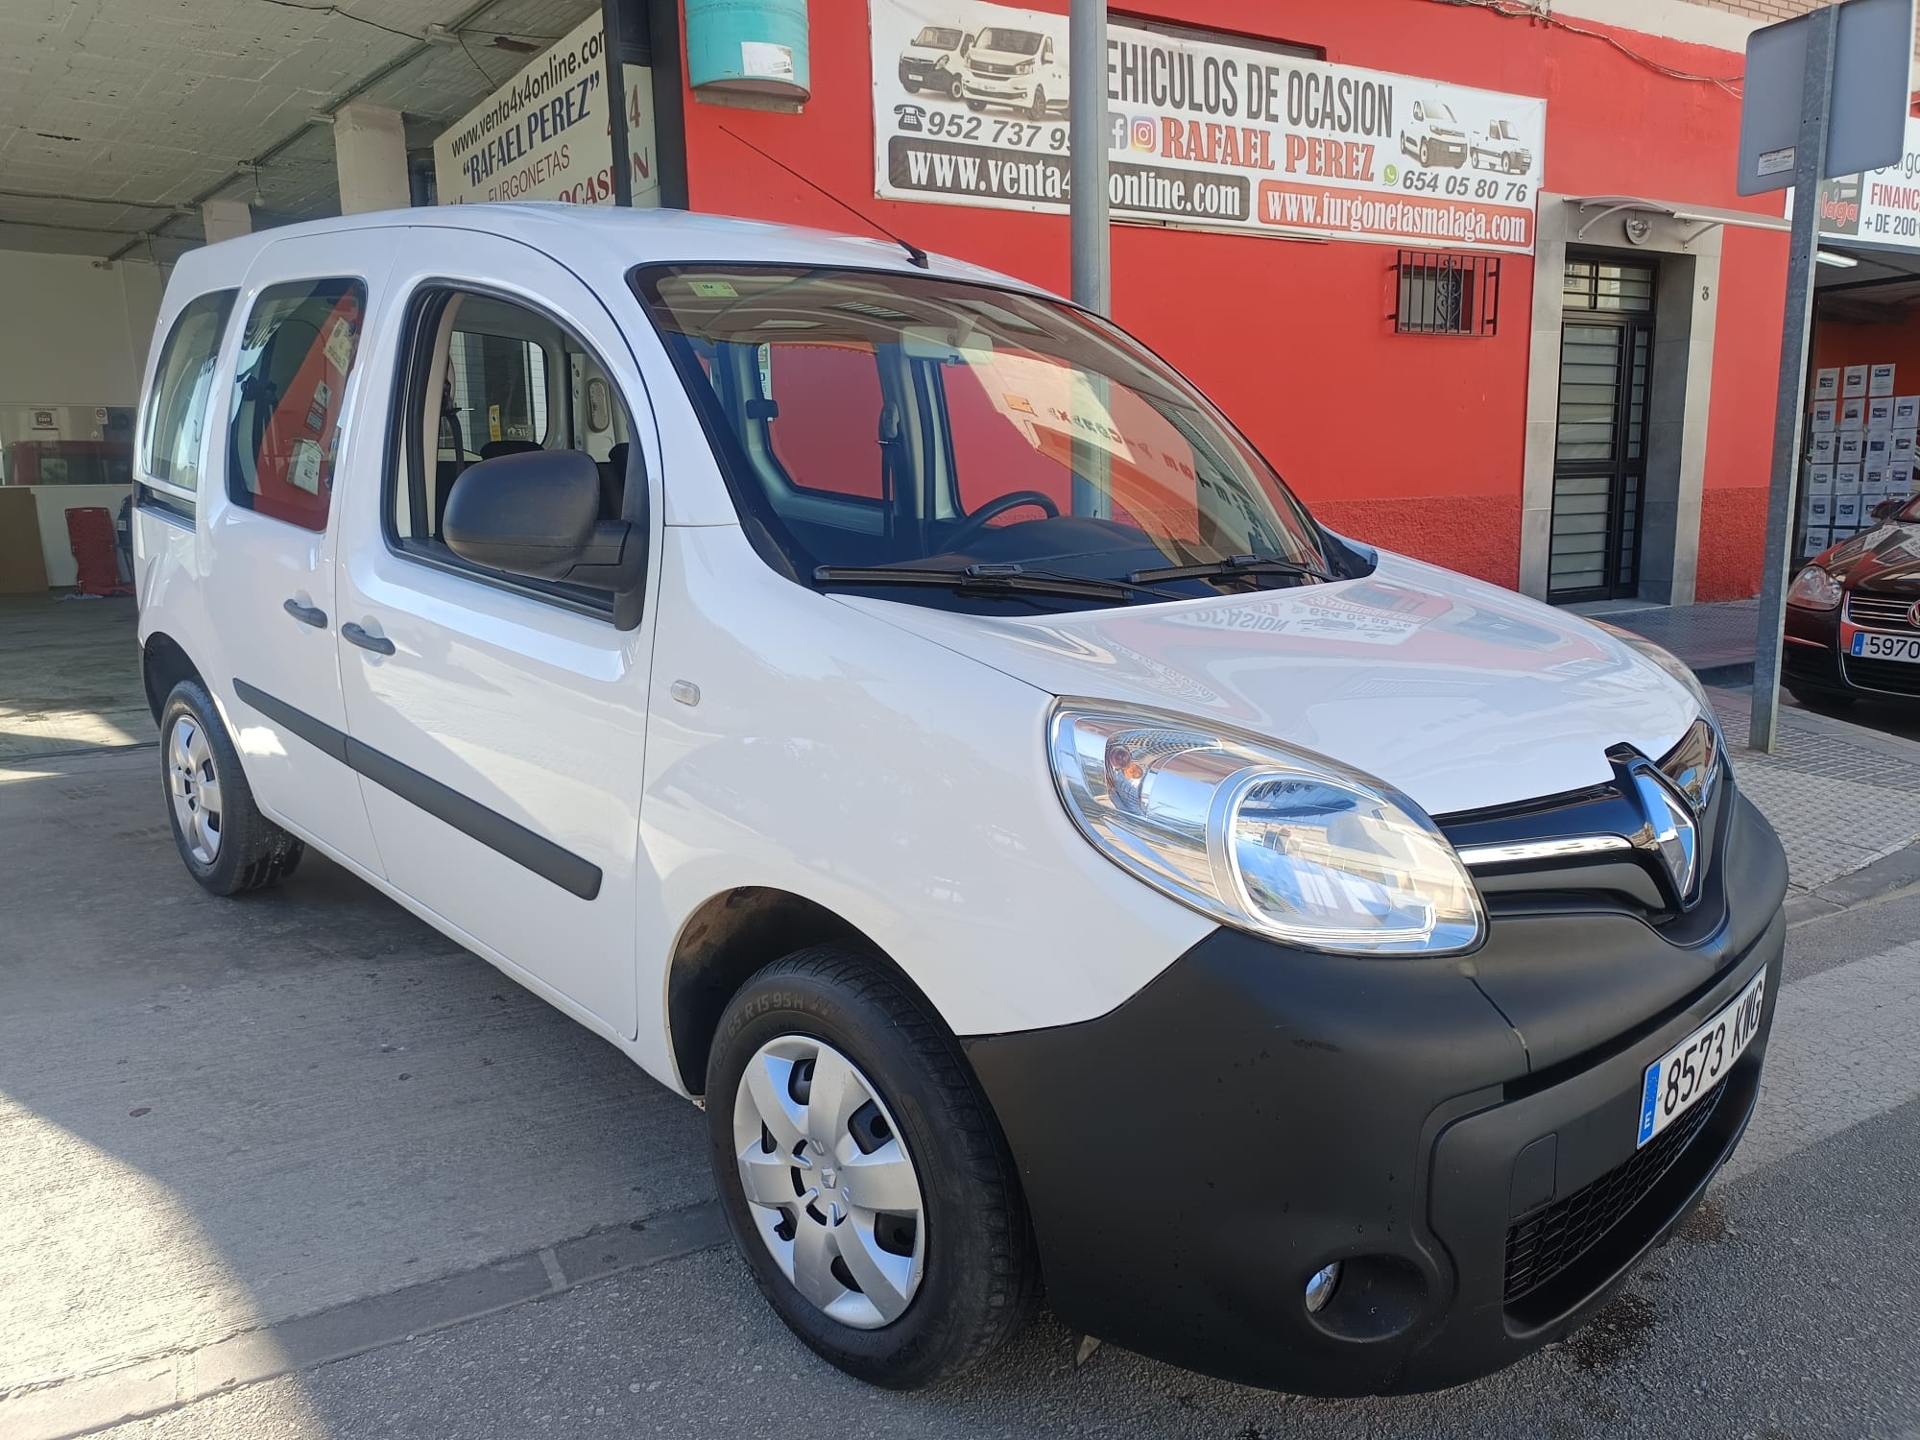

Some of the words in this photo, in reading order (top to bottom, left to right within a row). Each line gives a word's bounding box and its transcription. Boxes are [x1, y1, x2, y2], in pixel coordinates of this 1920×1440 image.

[1107, 40, 1238, 117] EHICULOS
[1246, 62, 1279, 124] DE
[1286, 70, 1392, 138] OCASION
[927, 111, 982, 141] 952
[991, 119, 1042, 148] 737
[1049, 127, 1070, 152] 9
[1160, 116, 1275, 171] RAFAEL
[1285, 133, 1375, 182] PEREZ
[488, 144, 571, 202] FURGONETAS
[558, 147, 649, 206] OCASIN
[907, 150, 1241, 217] www.venta4online.com
[1402, 170, 1439, 193] 654
[1445, 174, 1470, 196] 05
[1475, 178, 1499, 200] 80
[1504, 182, 1528, 203] 76
[1870, 182, 1920, 212] FINANC
[1266, 190, 1526, 244] www.furgonetasmalaga.com
[1875, 213, 1890, 234] DE
[1893, 215, 1917, 236] 200
[1869, 636, 1920, 659] 5970
[1664, 1022, 1725, 1117] 8573
